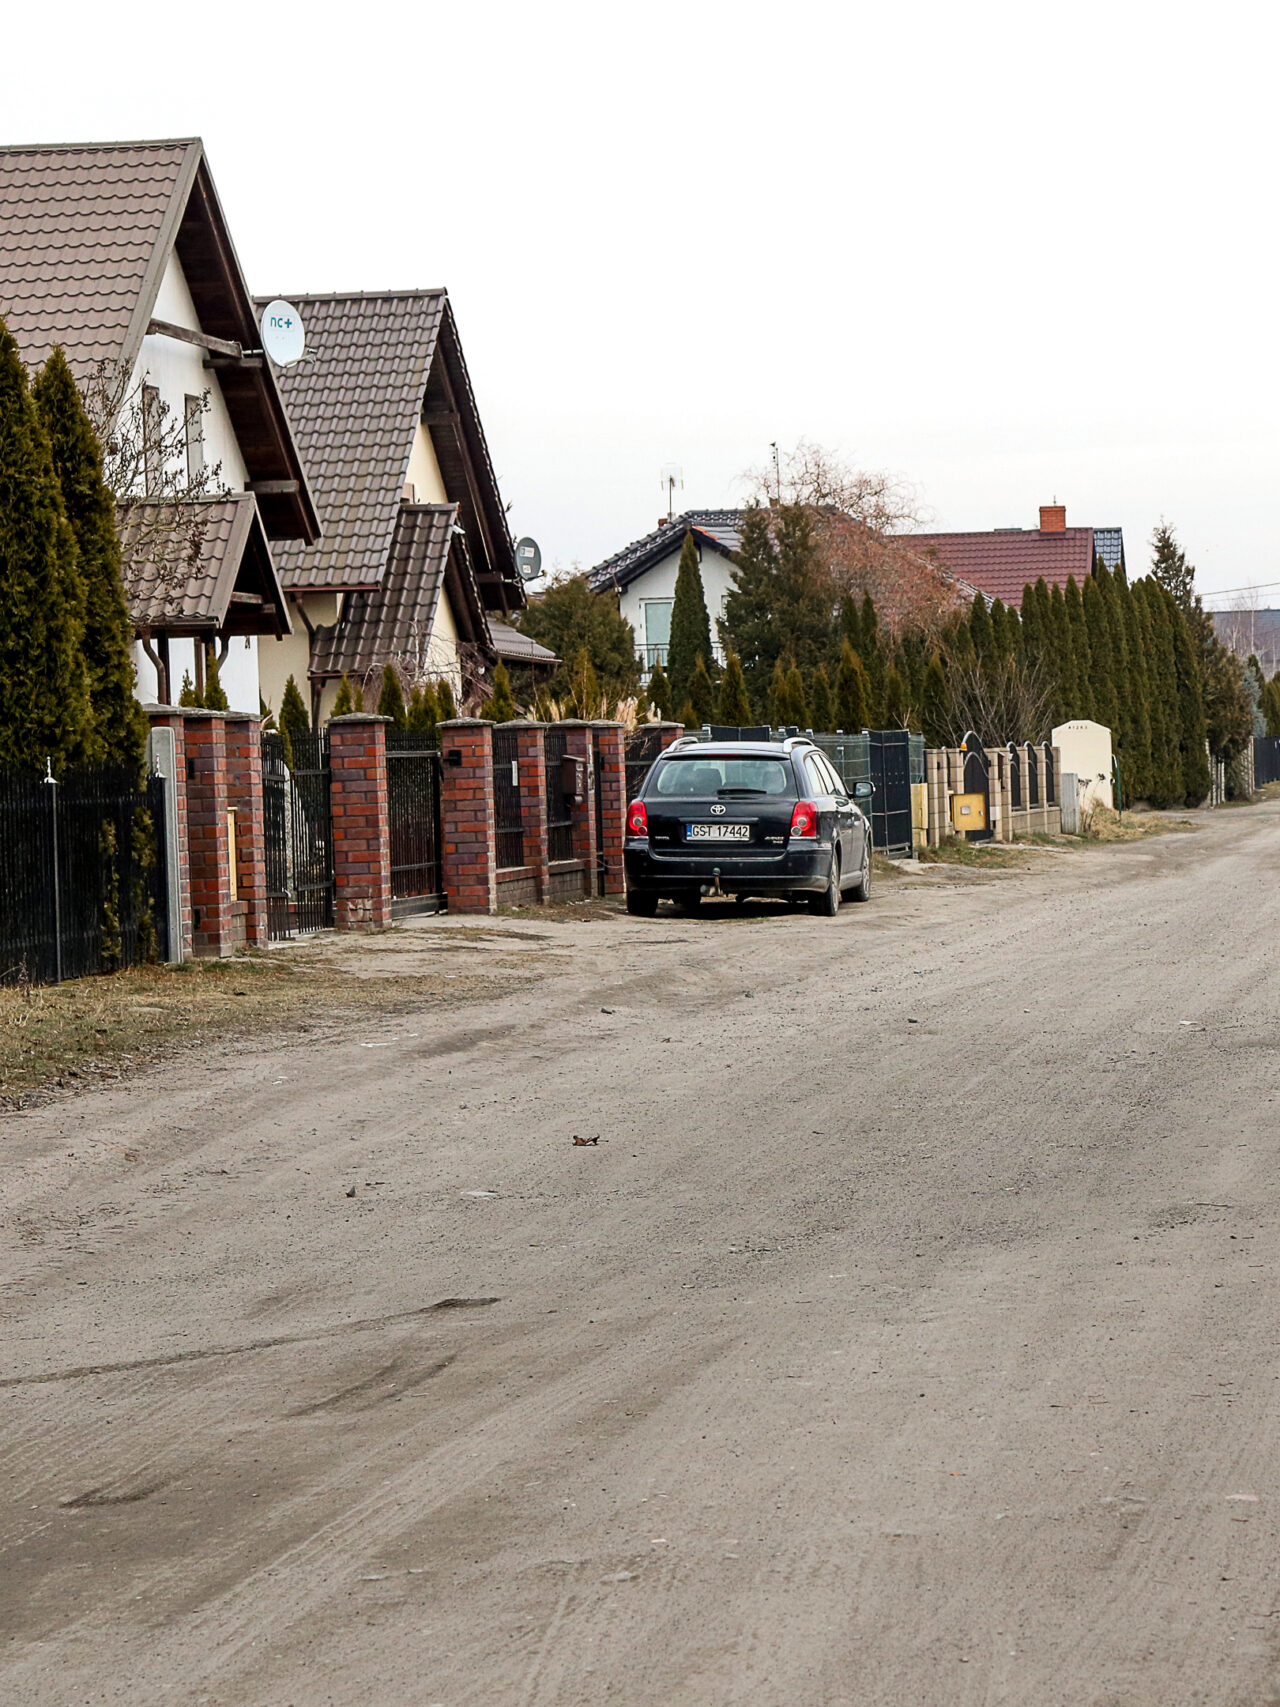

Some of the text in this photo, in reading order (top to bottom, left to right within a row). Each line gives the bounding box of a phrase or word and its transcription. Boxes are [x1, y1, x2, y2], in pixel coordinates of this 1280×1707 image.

[270, 316, 293, 329] nc+
[692, 825, 748, 837] GST 17442
